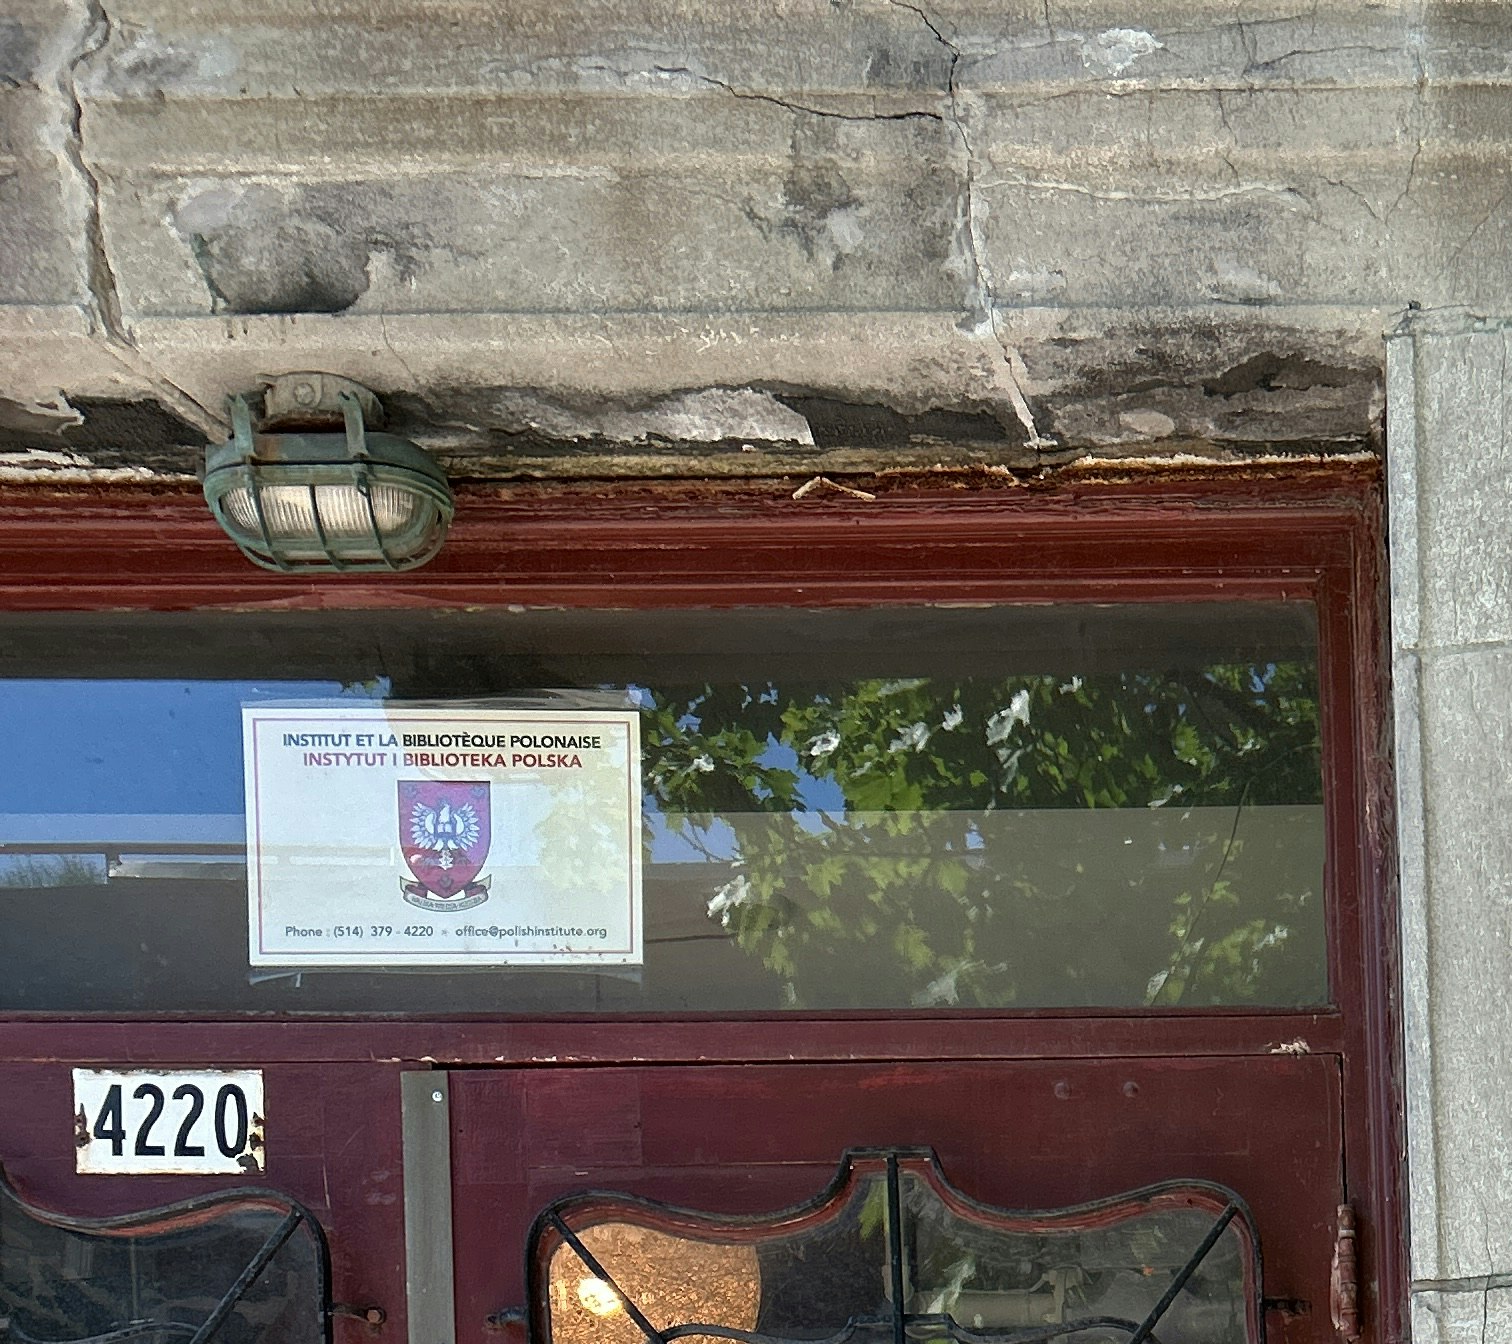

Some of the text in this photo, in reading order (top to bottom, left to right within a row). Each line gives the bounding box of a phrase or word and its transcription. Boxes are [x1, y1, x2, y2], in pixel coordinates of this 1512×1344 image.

[283, 731, 601, 749] INSTITUT ET LA BIBLIOTÈQUE POLONAISE
[303, 752, 583, 768] INSTYTUT I BIBLIOTEKA POLSKA
[285, 925, 323, 937] Phone
[333, 925, 364, 938] (514)
[370, 925, 393, 937] 379
[403, 925, 434, 937] 4220
[455, 925, 607, 939] office@polishinstitute.org
[93, 1083, 249, 1158] 4220
